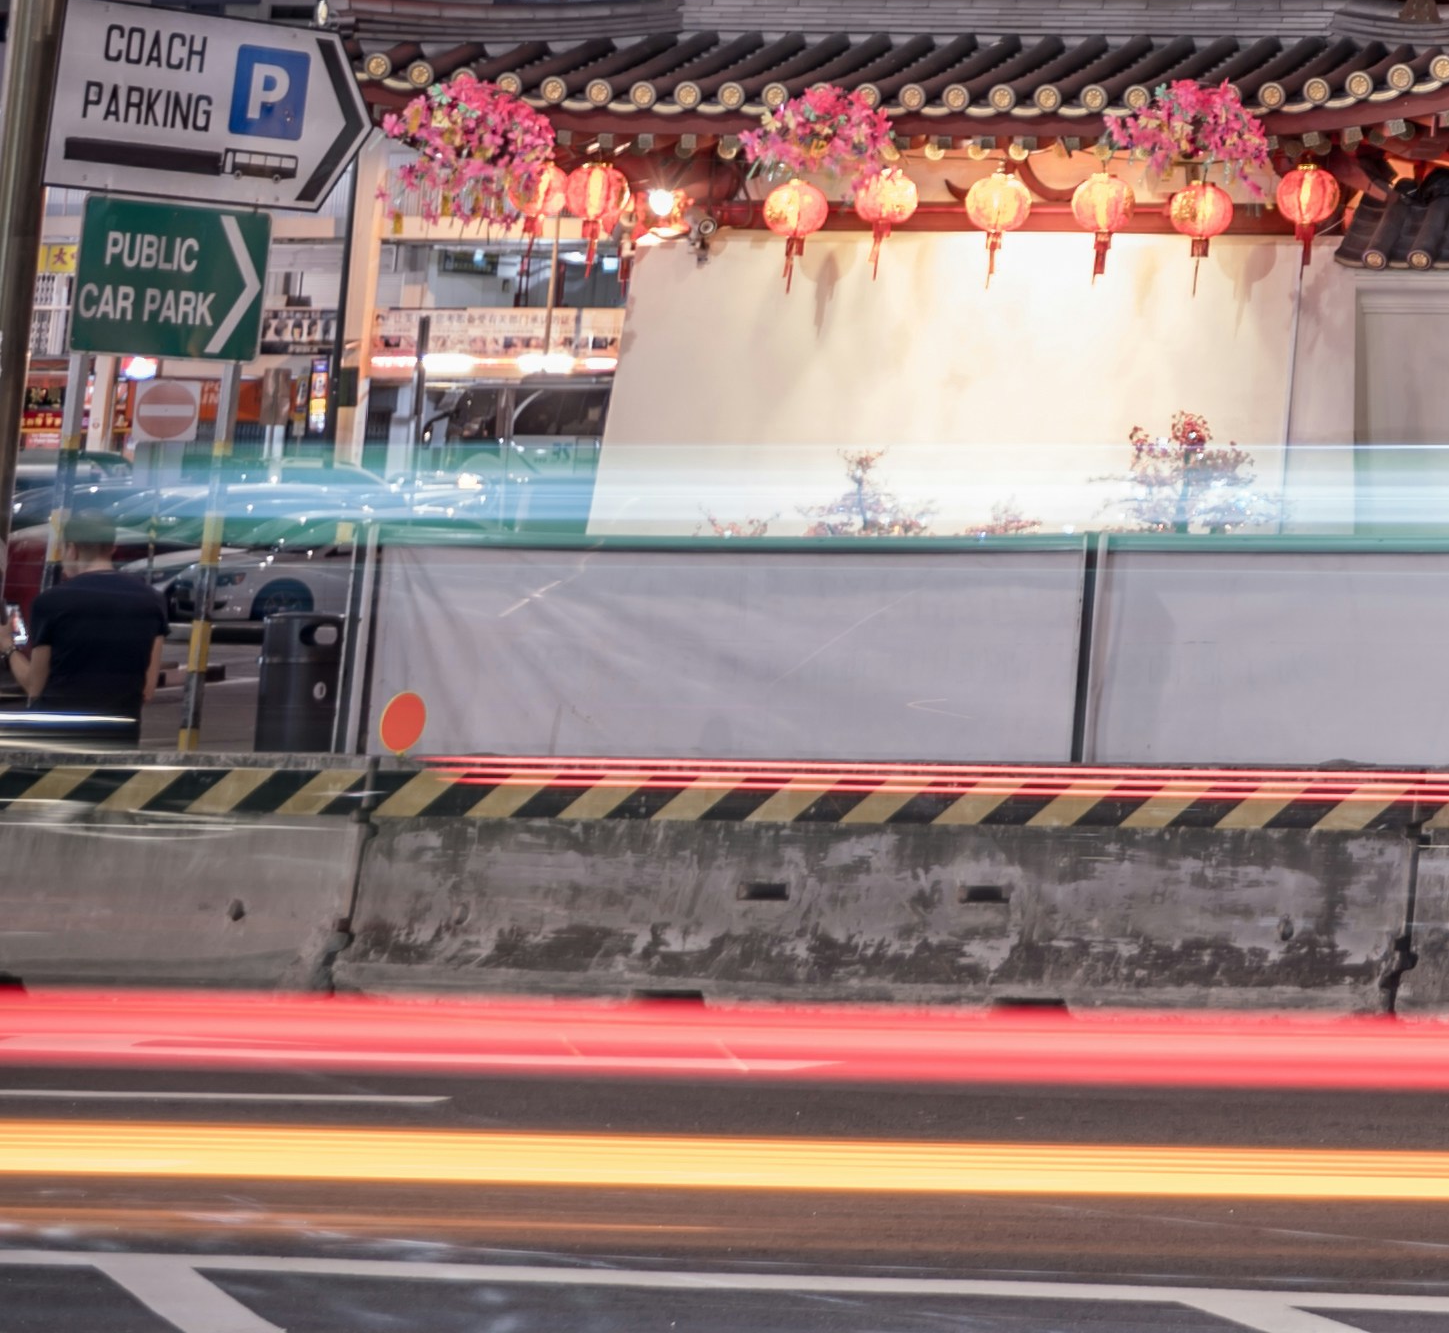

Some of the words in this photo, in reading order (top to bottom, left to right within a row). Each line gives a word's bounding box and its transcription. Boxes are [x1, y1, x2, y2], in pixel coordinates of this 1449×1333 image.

[103, 23, 208, 74] COACH
[81, 80, 213, 133] PARKING
[245, 62, 290, 120] P
[103, 230, 199, 274] PUBLIC
[78, 282, 135, 322] CAR
[142, 287, 217, 327] PARK
